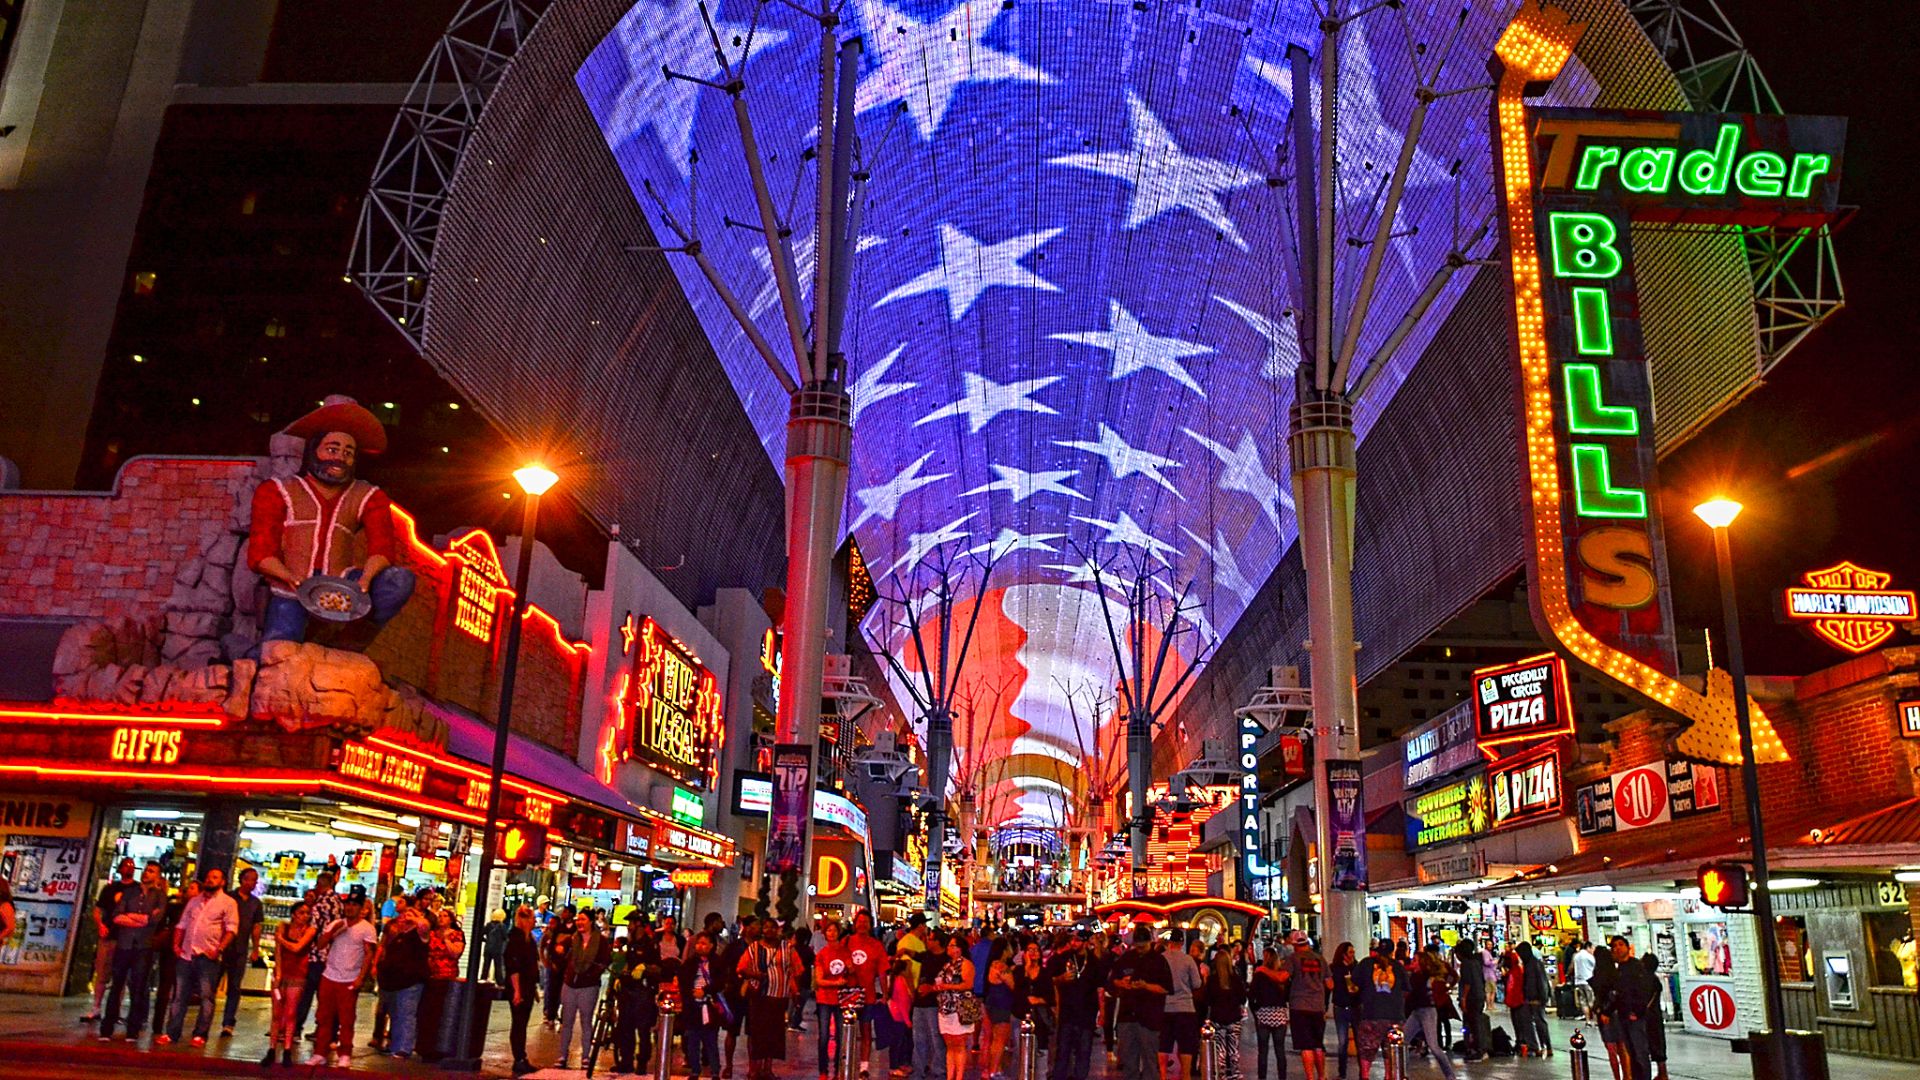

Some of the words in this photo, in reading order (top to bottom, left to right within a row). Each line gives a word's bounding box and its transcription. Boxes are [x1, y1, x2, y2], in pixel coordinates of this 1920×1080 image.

[1534, 118, 1831, 199] Trader
[1548, 211, 1658, 609] BILLS
[1818, 567, 1879, 589] MOTOR
[1792, 592, 1910, 615] HARLEY-DAVIDSON
[1825, 620, 1885, 646] CYCLES
[1501, 666, 1548, 688] PICCADILLY
[1510, 682, 1542, 698] CIRCUS
[1490, 696, 1545, 729] PIZZA
[112, 729, 181, 763] GIFTS
[1417, 784, 1467, 815] SOUVENIRS
[1511, 760, 1555, 810] PIZZA
[1622, 773, 1653, 821] $10
[1422, 804, 1463, 829] T-SHIRTS
[1418, 819, 1469, 846] BEVERAGES
[51, 872, 72, 881] FOR
[671, 872, 709, 884] LIQUOR
[817, 855, 849, 896] D
[1696, 988, 1724, 1026] $10
